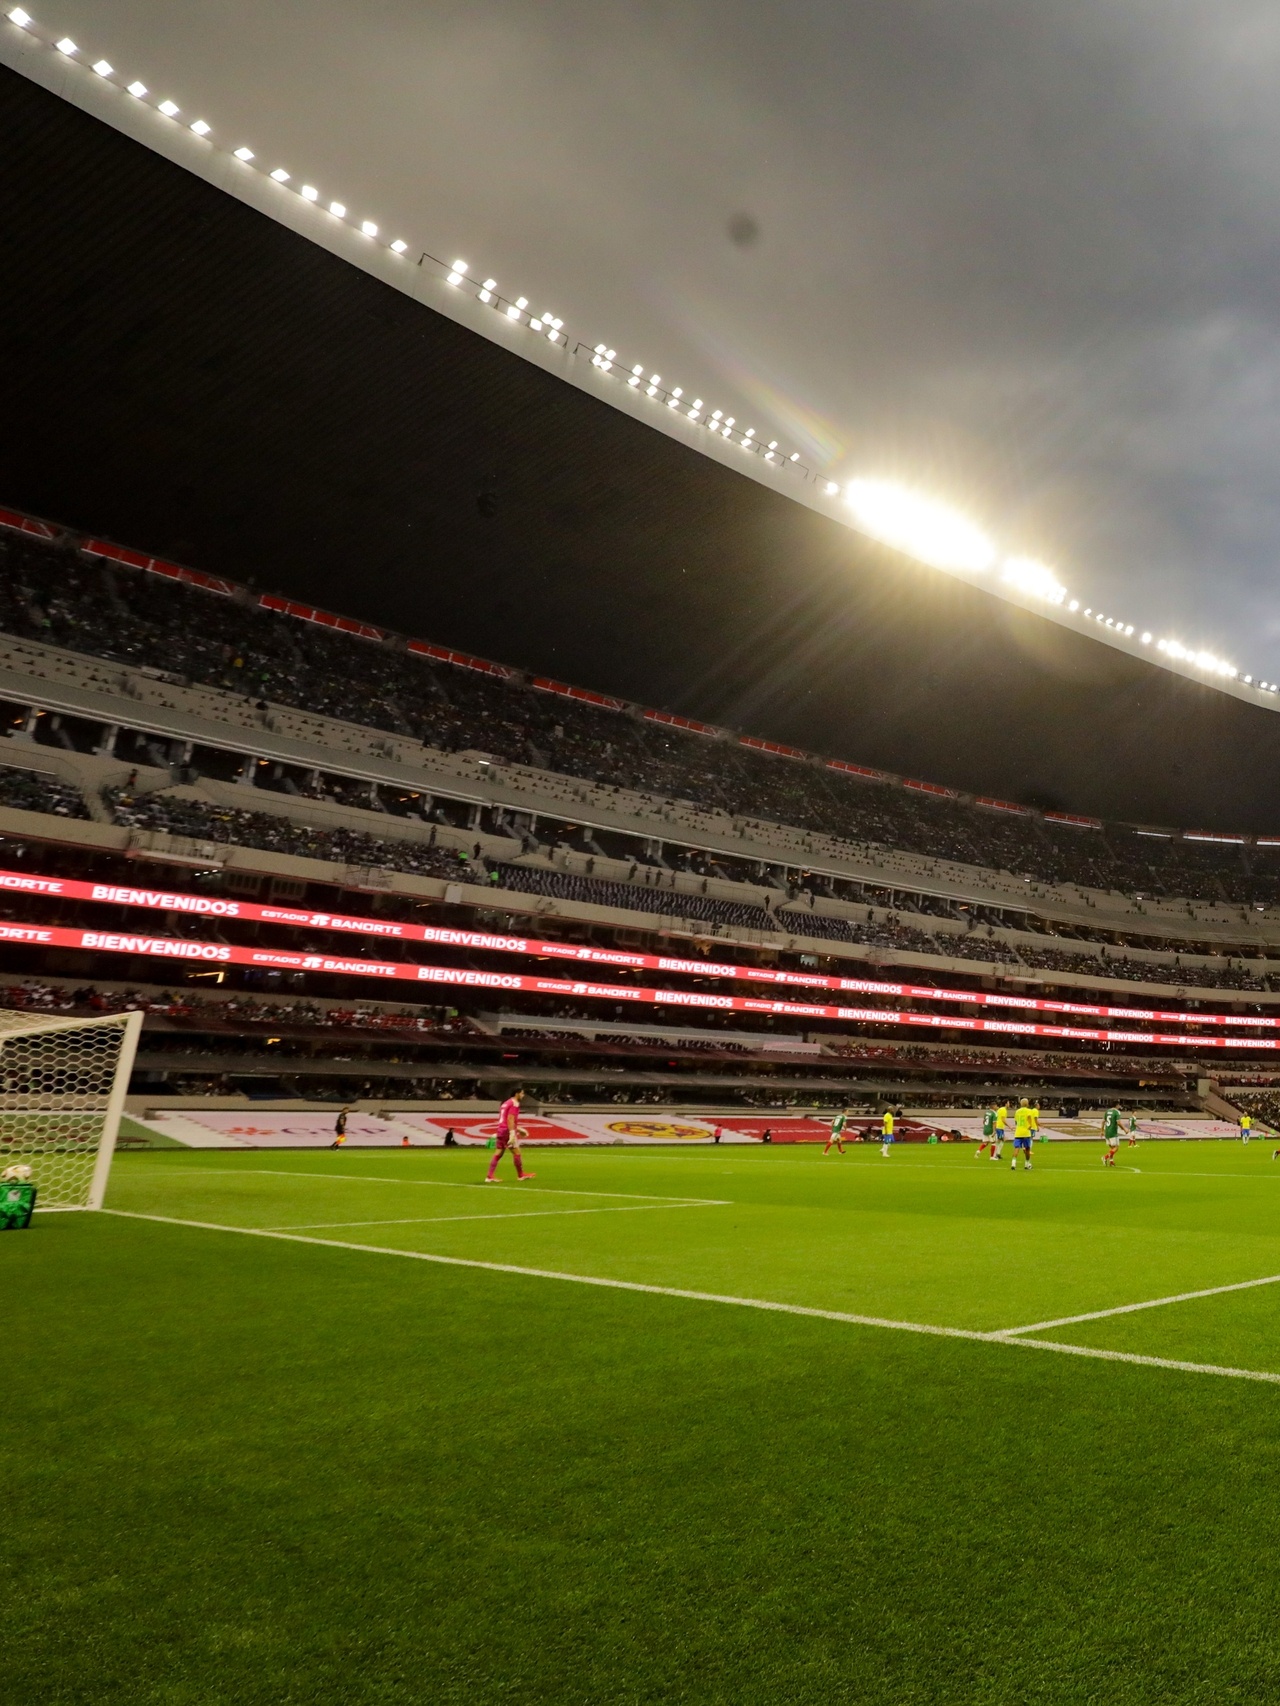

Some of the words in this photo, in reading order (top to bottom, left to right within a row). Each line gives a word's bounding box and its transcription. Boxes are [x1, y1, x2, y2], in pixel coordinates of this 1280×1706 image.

[81, 933, 230, 960] BIENVENIDOS
[253, 954, 300, 964] ESTADIO
[324, 961, 395, 975] BANORTE
[418, 968, 521, 988] BIENVENIDOS
[537, 982, 572, 990] ESTADIO
[588, 987, 640, 998] BANORTE
[655, 991, 733, 1007] BIENVENIDOS
[783, 1004, 825, 1015] BANORTE
[838, 1008, 900, 1022] BIENVENIDOS
[940, 1018, 974, 1027] BANORTE
[984, 1022, 1035, 1033] BIENVENIDOS
[1107, 1032, 1153, 1042] BIENVENIDOS
[1225, 1039, 1276, 1047] BIENVENIDOS
[92, 886, 239, 915] BIENVENIDOS
[261, 910, 308, 921] ESTADIO
[331, 919, 402, 934] BANORTE
[424, 929, 526, 950] BIENVENIDOS
[542, 946, 576, 955] ESTADIO
[592, 952, 644, 964] BANORTE
[659, 959, 736, 976] BIENVENIDOS
[787, 976, 828, 985] BANORTE
[841, 980, 902, 994] BIENVENIDOS
[986, 995, 1037, 1008] BIENVENIDOS
[1108, 1008, 1154, 1019] BIENVENIDOS
[1225, 1017, 1275, 1026] BIENVENIDOS
